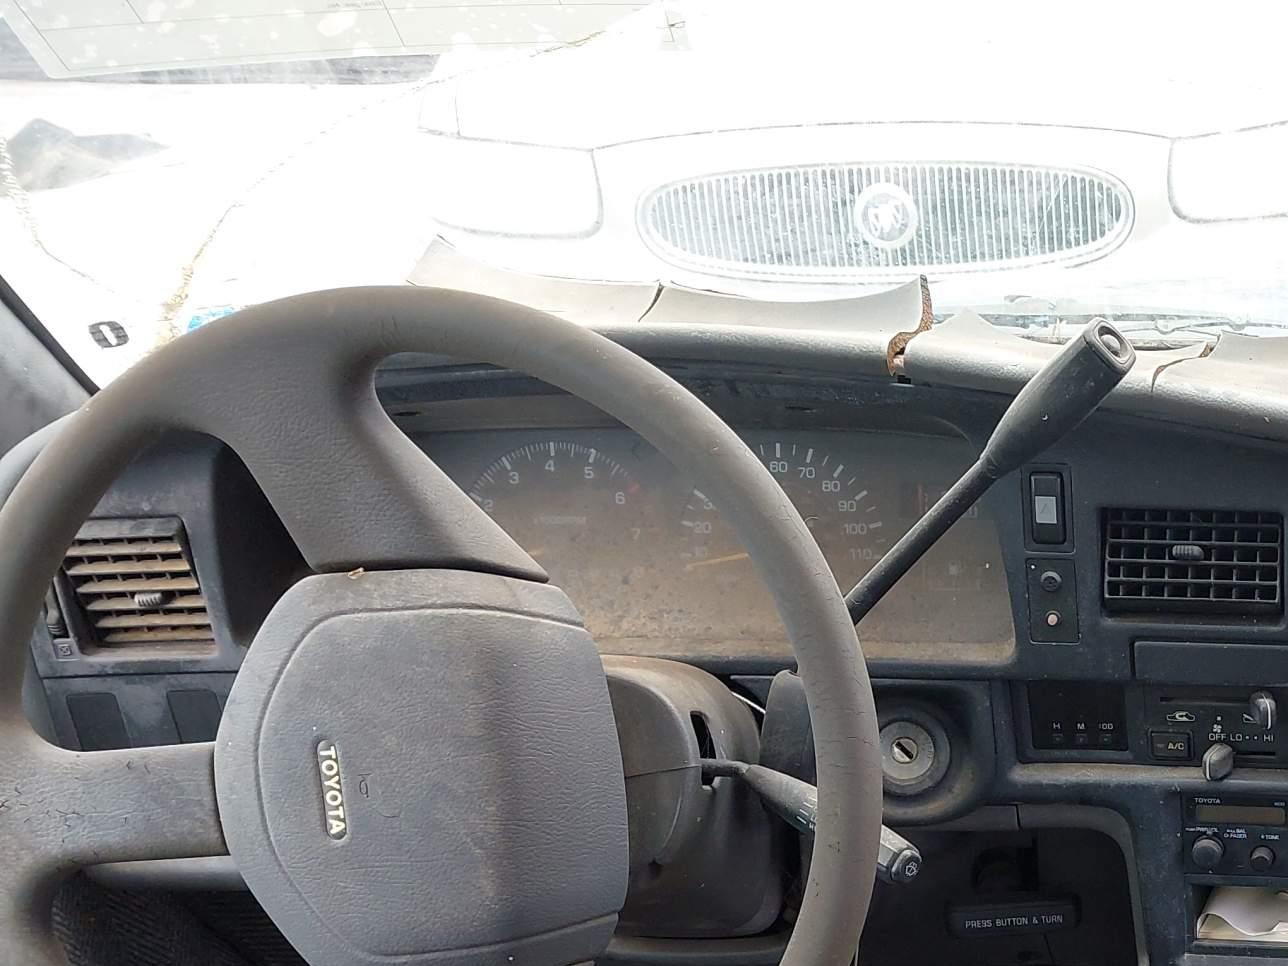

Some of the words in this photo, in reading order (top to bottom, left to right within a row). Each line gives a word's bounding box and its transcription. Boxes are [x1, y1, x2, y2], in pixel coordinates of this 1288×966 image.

[544, 460, 555, 472] 4
[584, 466, 595, 479] 5
[769, 461, 788, 473] 60
[799, 466, 816, 479] 70
[508, 471, 520, 484] 3
[822, 480, 841, 492] 80
[615, 491, 626, 504] 6
[838, 501, 857, 513] 90
[693, 521, 712, 534] 20
[843, 522, 868, 535] 100
[1052, 722, 1061, 730] H
[1077, 722, 1086, 730] M
[1208, 733, 1227, 742] OFF
[1230, 733, 1243, 742] LO
[1263, 734, 1274, 742] HI
[318, 745, 347, 835] TOYOTA
[965, 919, 993, 929] PRESS
[995, 916, 1029, 927] BUTTON
[1032, 916, 1039, 924] &
[1041, 914, 1063, 924] TURN
